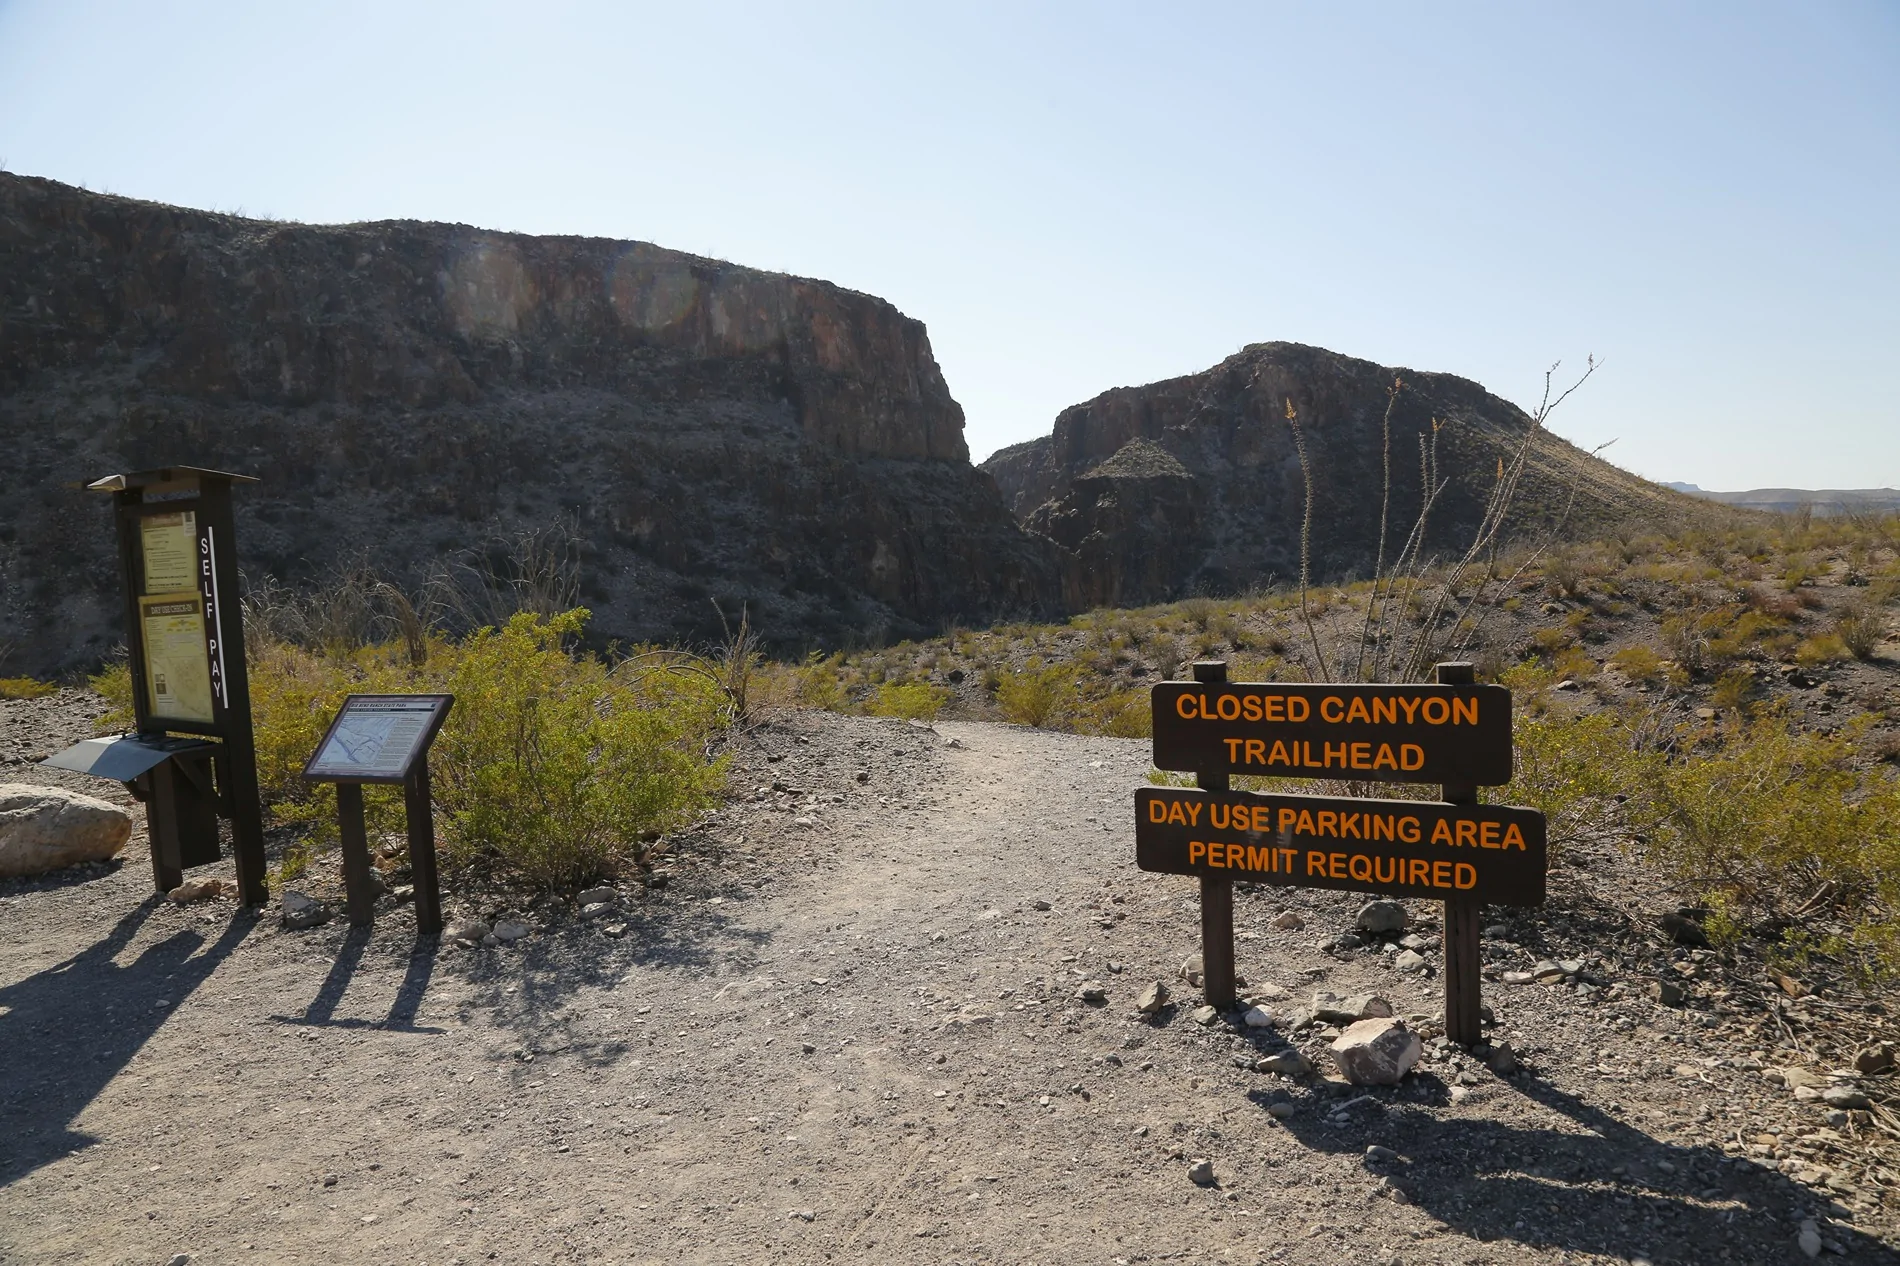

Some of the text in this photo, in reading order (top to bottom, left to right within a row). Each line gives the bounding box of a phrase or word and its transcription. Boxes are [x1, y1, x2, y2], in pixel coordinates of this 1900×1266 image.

[150, 606, 161, 615] DAY
[201, 537, 221, 698] SELF PAY
[1176, 693, 1478, 725] CLOSED CANYON
[1223, 738, 1425, 771] TRAILHEAD
[1149, 799, 1527, 851] DAY USE PARKING AREA
[1189, 841, 1477, 889] PERMIT REQUIRED
